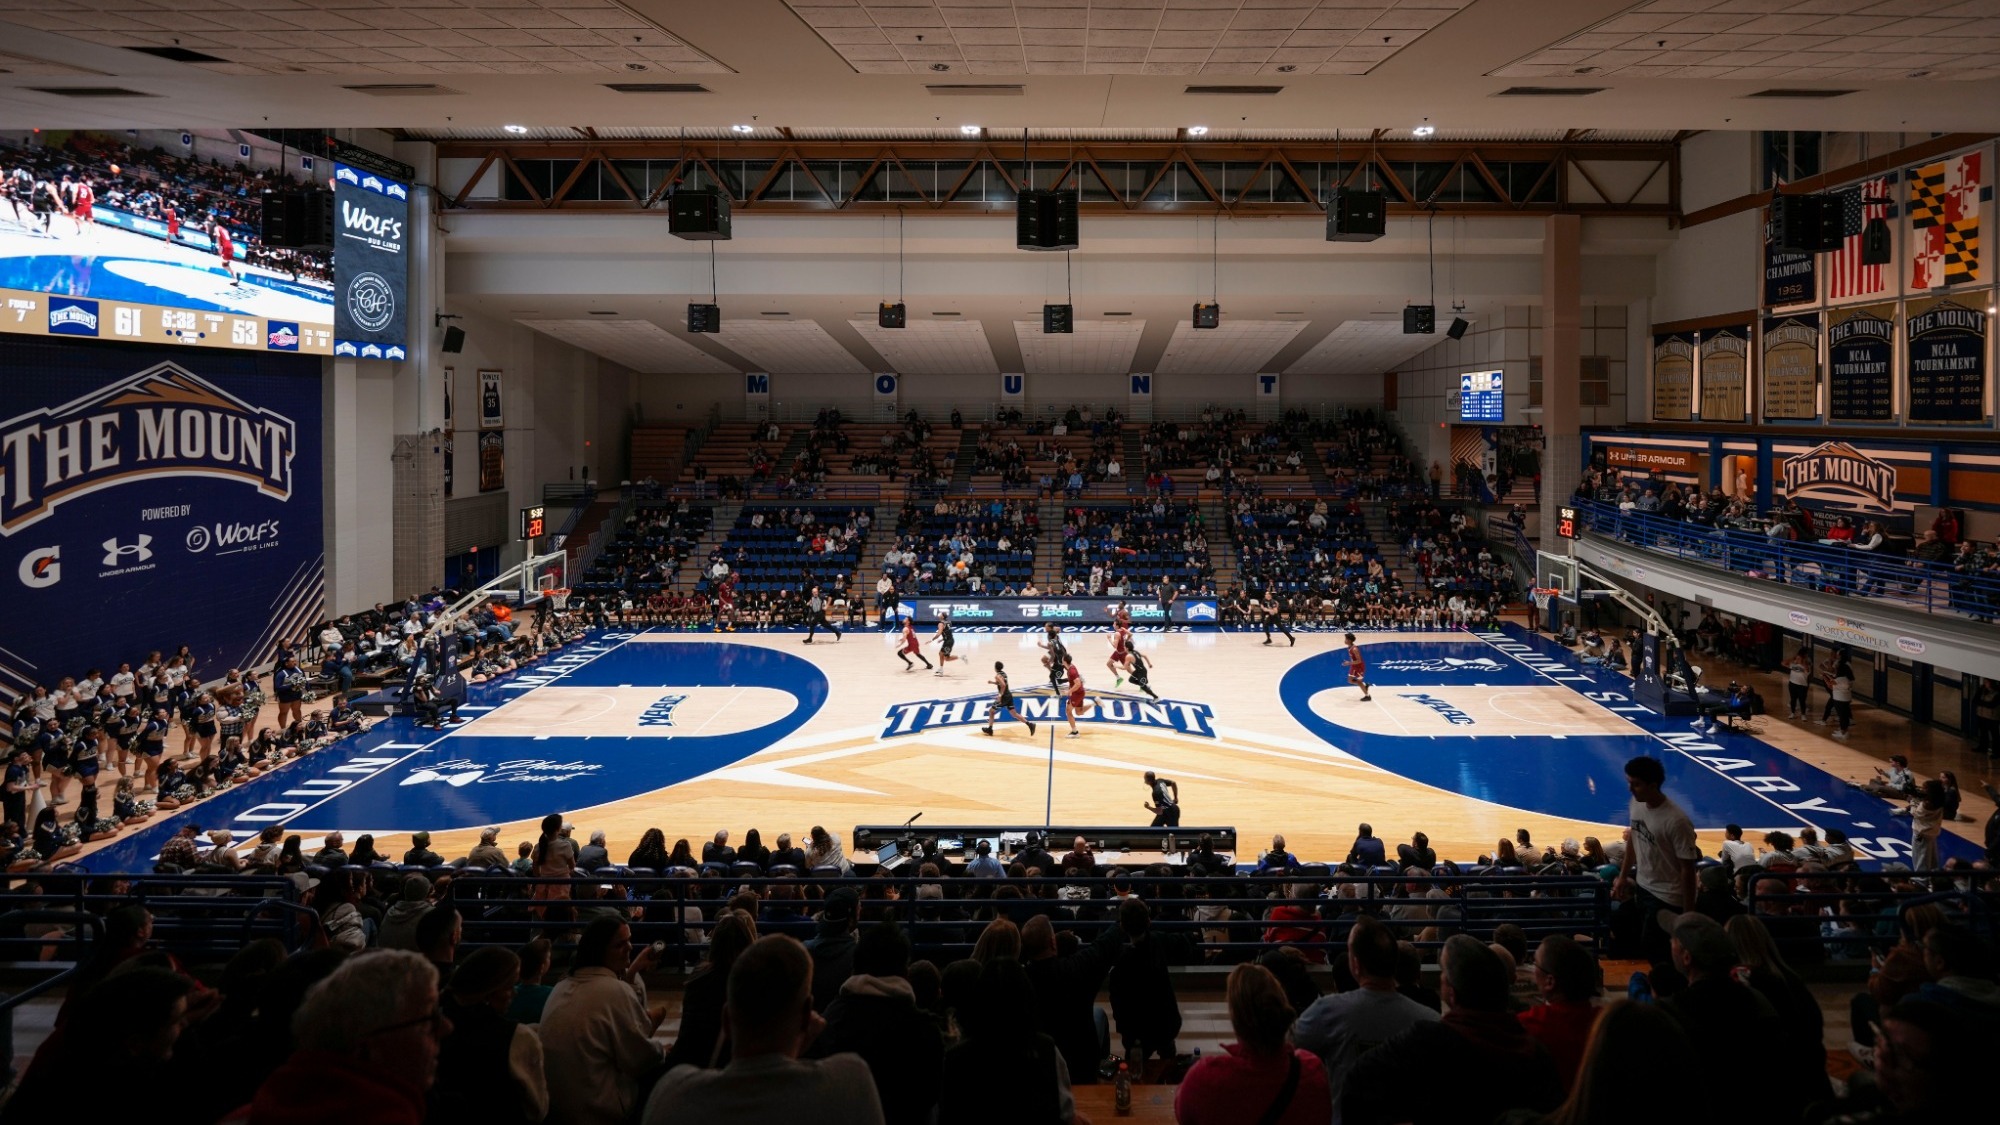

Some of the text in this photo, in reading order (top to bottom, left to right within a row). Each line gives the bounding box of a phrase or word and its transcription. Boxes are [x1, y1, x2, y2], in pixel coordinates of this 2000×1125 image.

[342, 200, 401, 239] WOLF'S
[1766, 260, 1812, 279] CHAMPIONS
[17, 309, 26, 322] 7
[115, 307, 142, 336] 61
[162, 309, 196, 330] 5:32
[1908, 310, 1985, 338] THE MOUNT
[232, 319, 258, 345] 53
[1830, 321, 1892, 345] THE MOUNT
[1849, 349, 1871, 362] NCAA
[1931, 342, 1958, 357] NCAA
[1834, 361, 1886, 375] TOURNAMENT
[1914, 356, 1977, 371] TOURNAMENT
[747, 375, 1277, 394] M O U N T
[4, 406, 287, 510] THE MOUNT
[1648, 456, 1686, 466] ARMOUR
[1786, 457, 1892, 502] THE MOUNT
[142, 504, 191, 522] POWERED BY
[216, 520, 280, 548] WOLF'S
[529, 519, 543, 537] 28
[1560, 519, 1573, 537] 28
[243, 541, 279, 553] BUS LINES
[18, 545, 61, 588] G
[98, 563, 156, 578] UNDER ARMOUR
[952, 609, 994, 617] SPORTS
[1041, 609, 1083, 617] SPORTS
[1815, 622, 1845, 636] SPORTS
[1846, 630, 1890, 649] COMPLEX
[1846, 619, 1865, 631] PNC
[500, 632, 637, 689] MARY'S
[1474, 632, 1597, 684] MOUNT
[637, 693, 692, 728] MAAC
[892, 699, 1002, 733] THE
[1584, 691, 1658, 721] ST.
[1654, 731, 1913, 859] MARY'S
